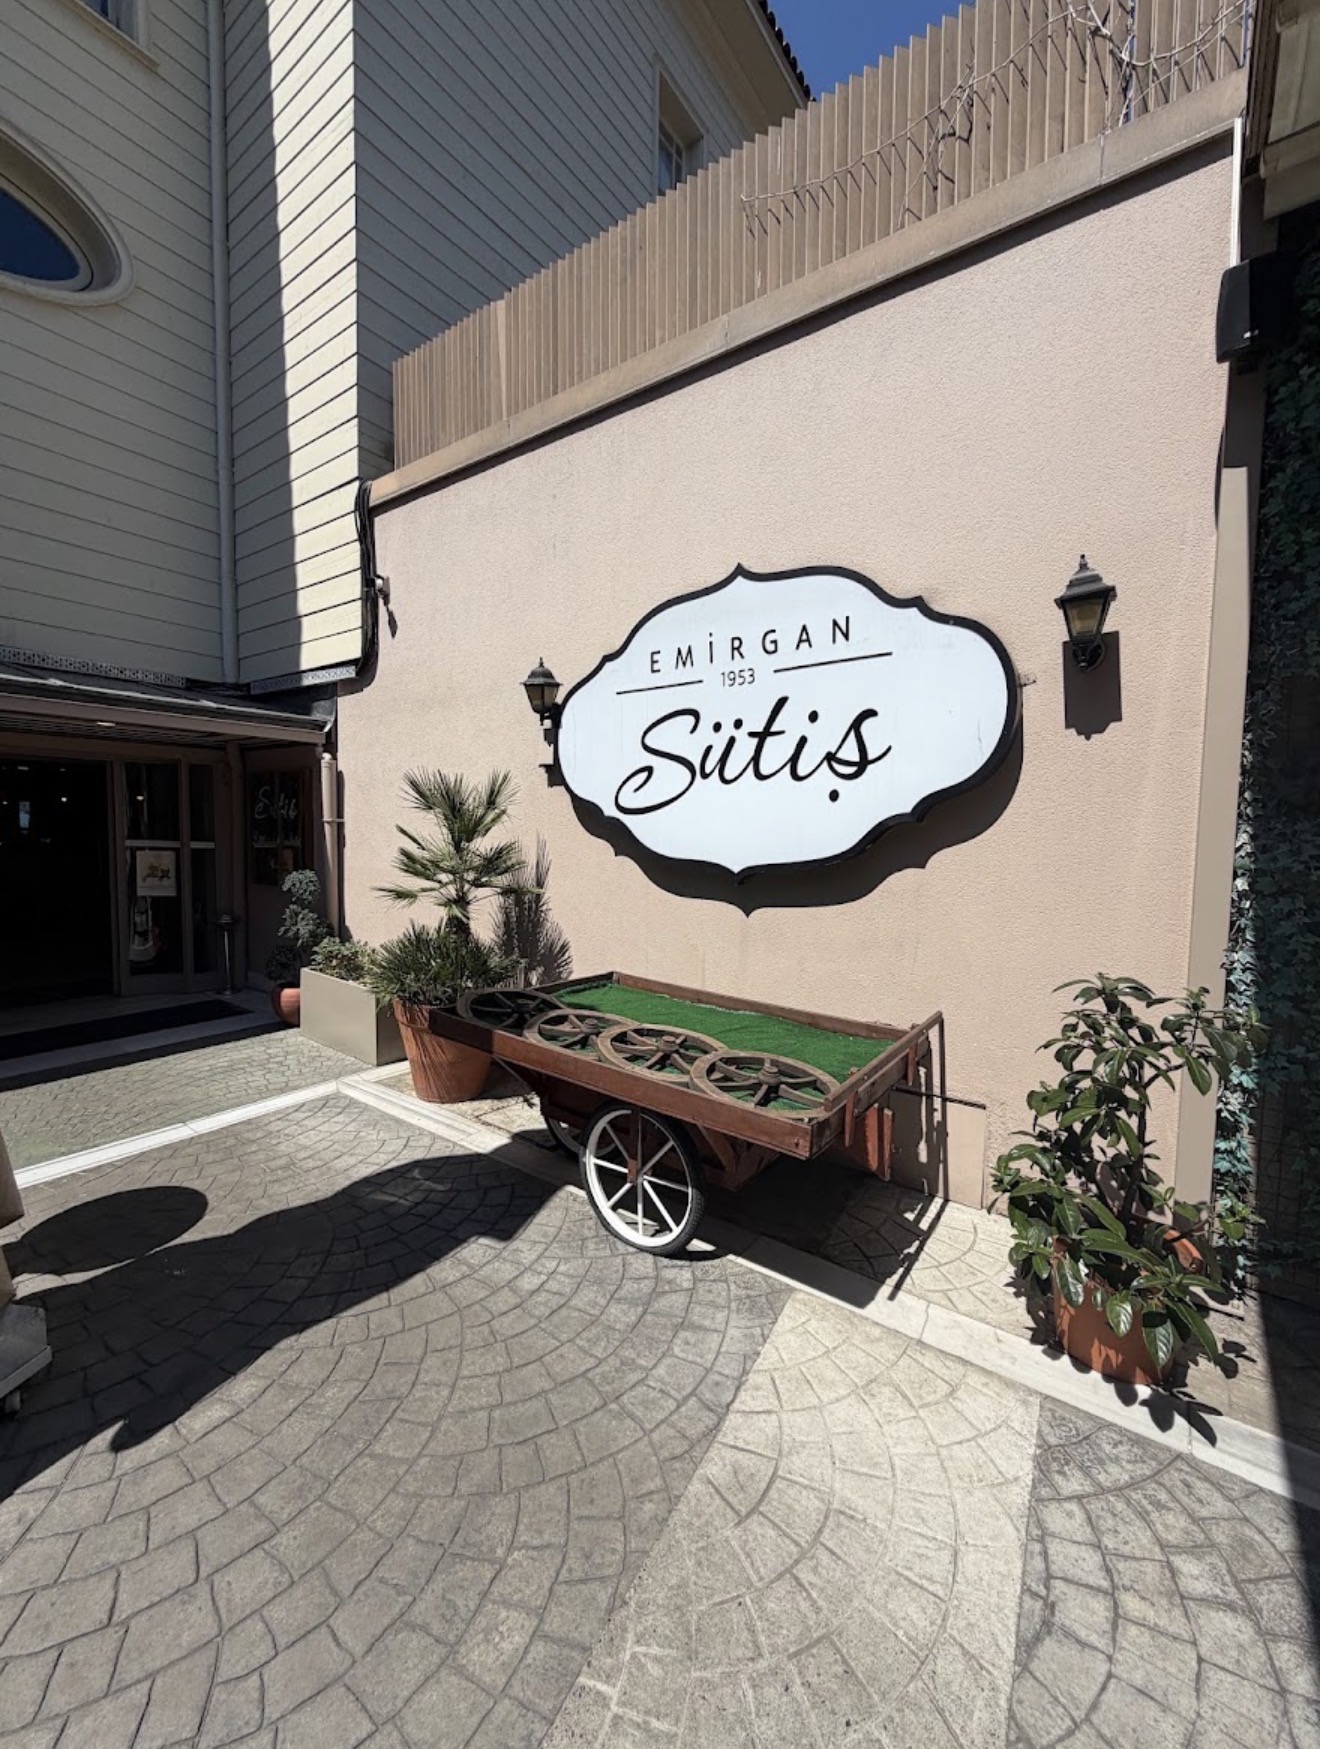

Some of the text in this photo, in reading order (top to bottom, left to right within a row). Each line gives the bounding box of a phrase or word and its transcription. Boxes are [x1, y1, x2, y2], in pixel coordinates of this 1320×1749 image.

[651, 615, 850, 674] EMİRGAN
[720, 668, 756, 688] 1953
[615, 696, 892, 815] Sütiş
